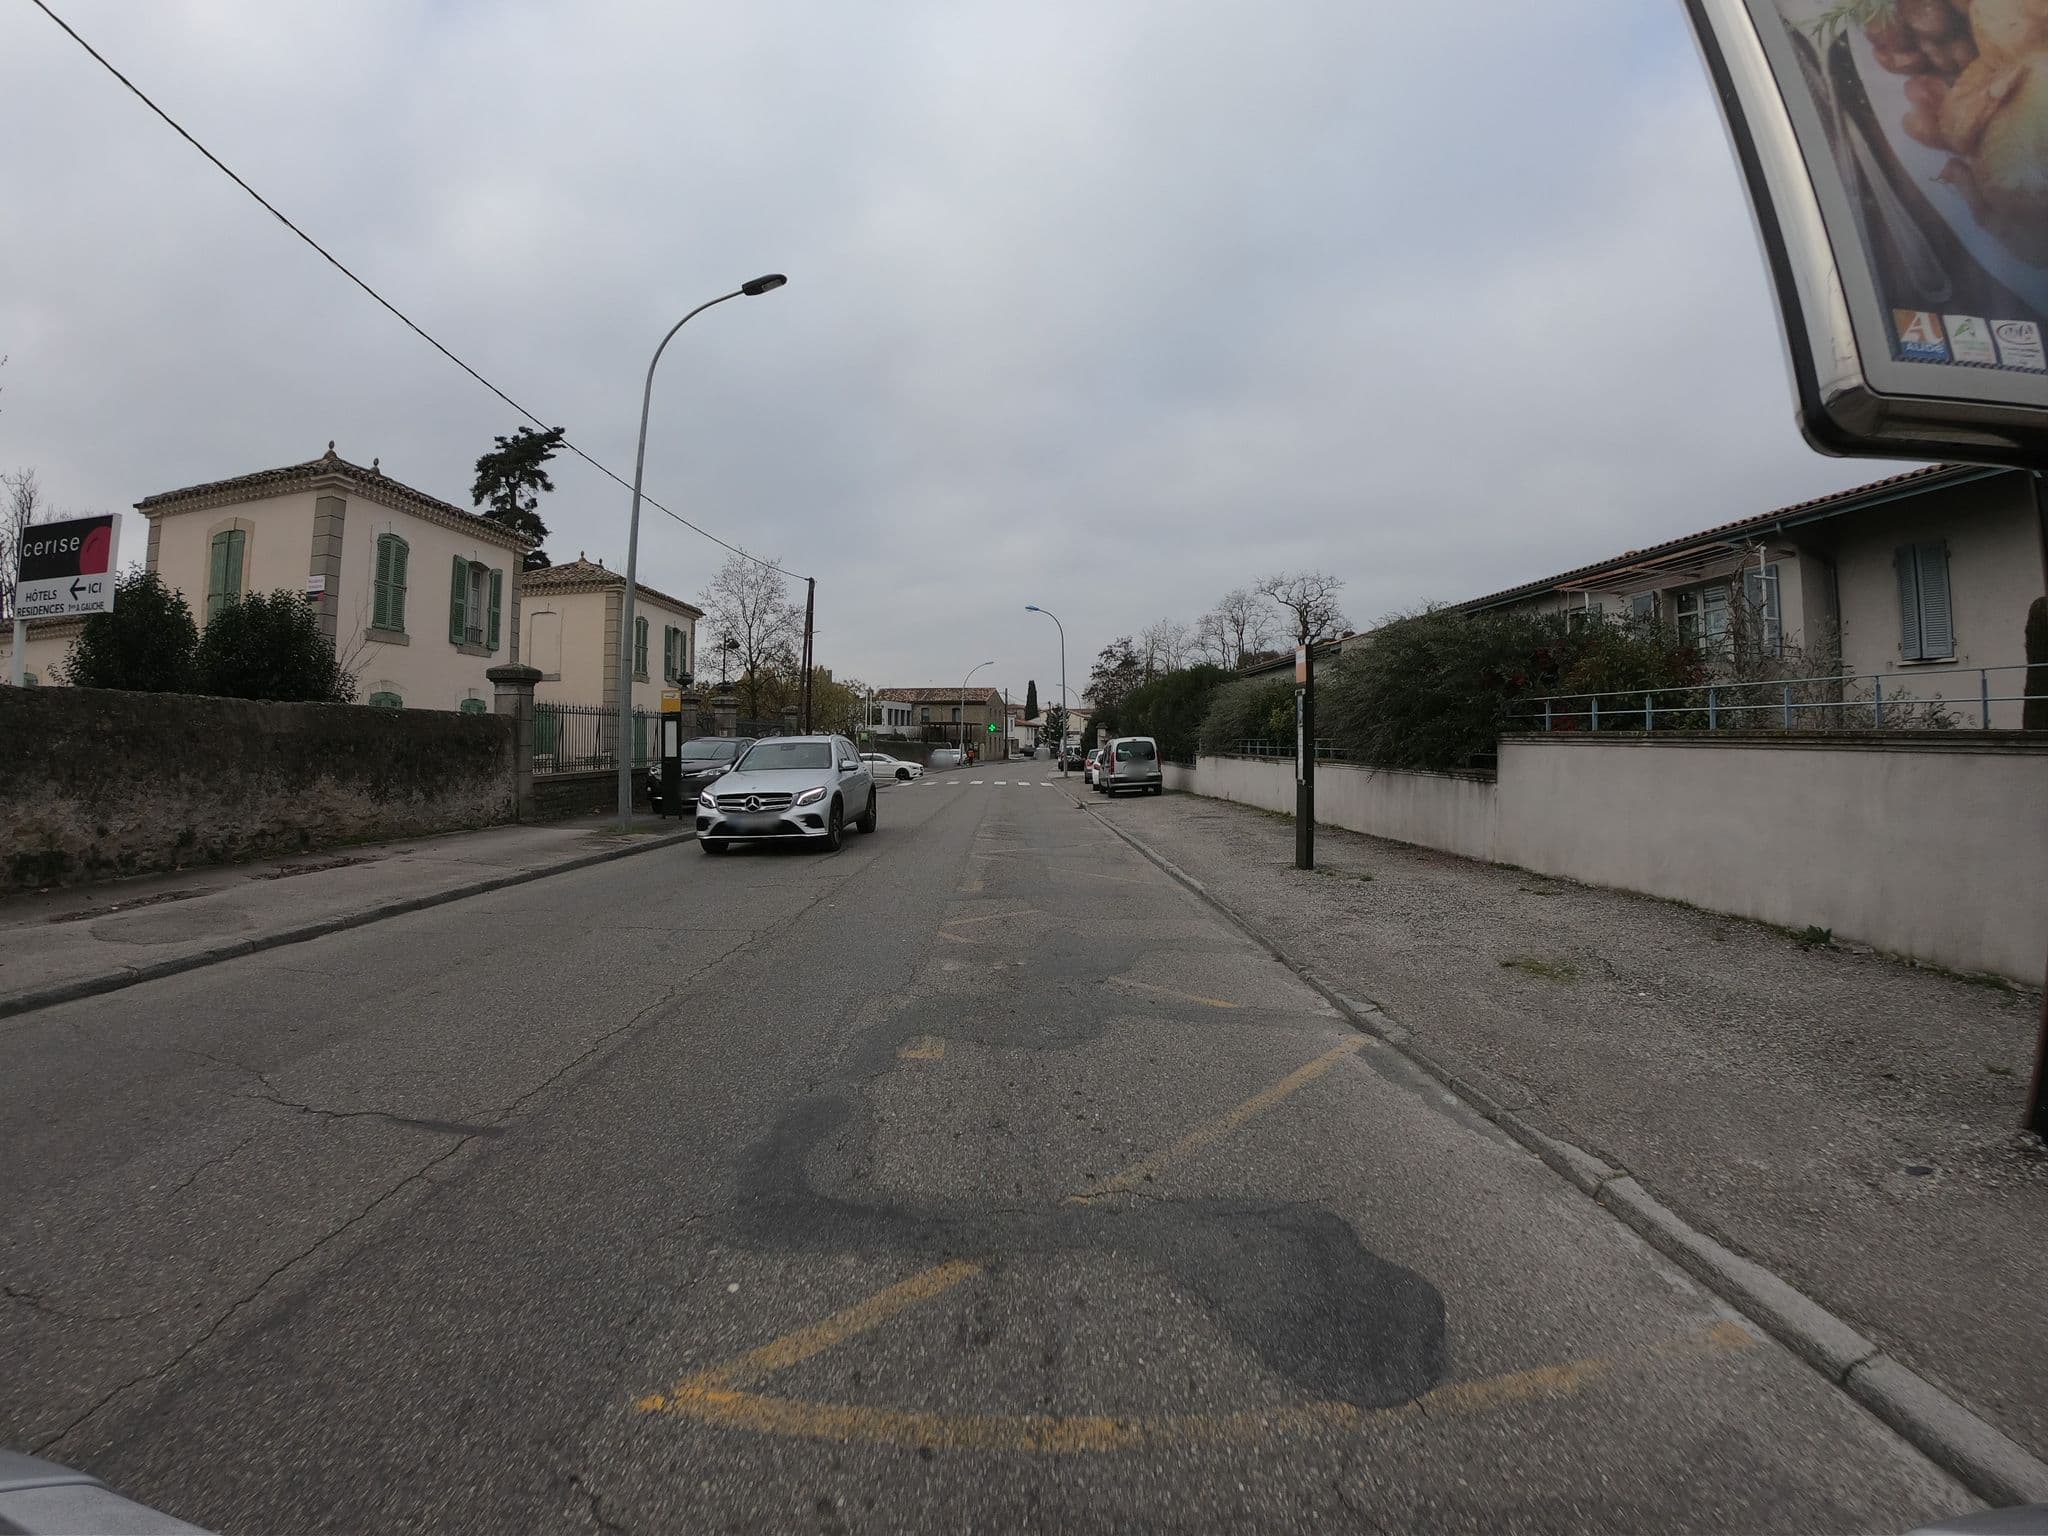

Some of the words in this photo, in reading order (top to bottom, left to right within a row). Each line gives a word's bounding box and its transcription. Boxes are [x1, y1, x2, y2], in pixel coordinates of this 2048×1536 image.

[23, 537, 80, 557] cerise
[88, 583, 102, 594] ICI
[25, 589, 57, 602] HÔTELS
[17, 604, 64, 617] RESIDENCES
[81, 601, 104, 611] GAUCHE
